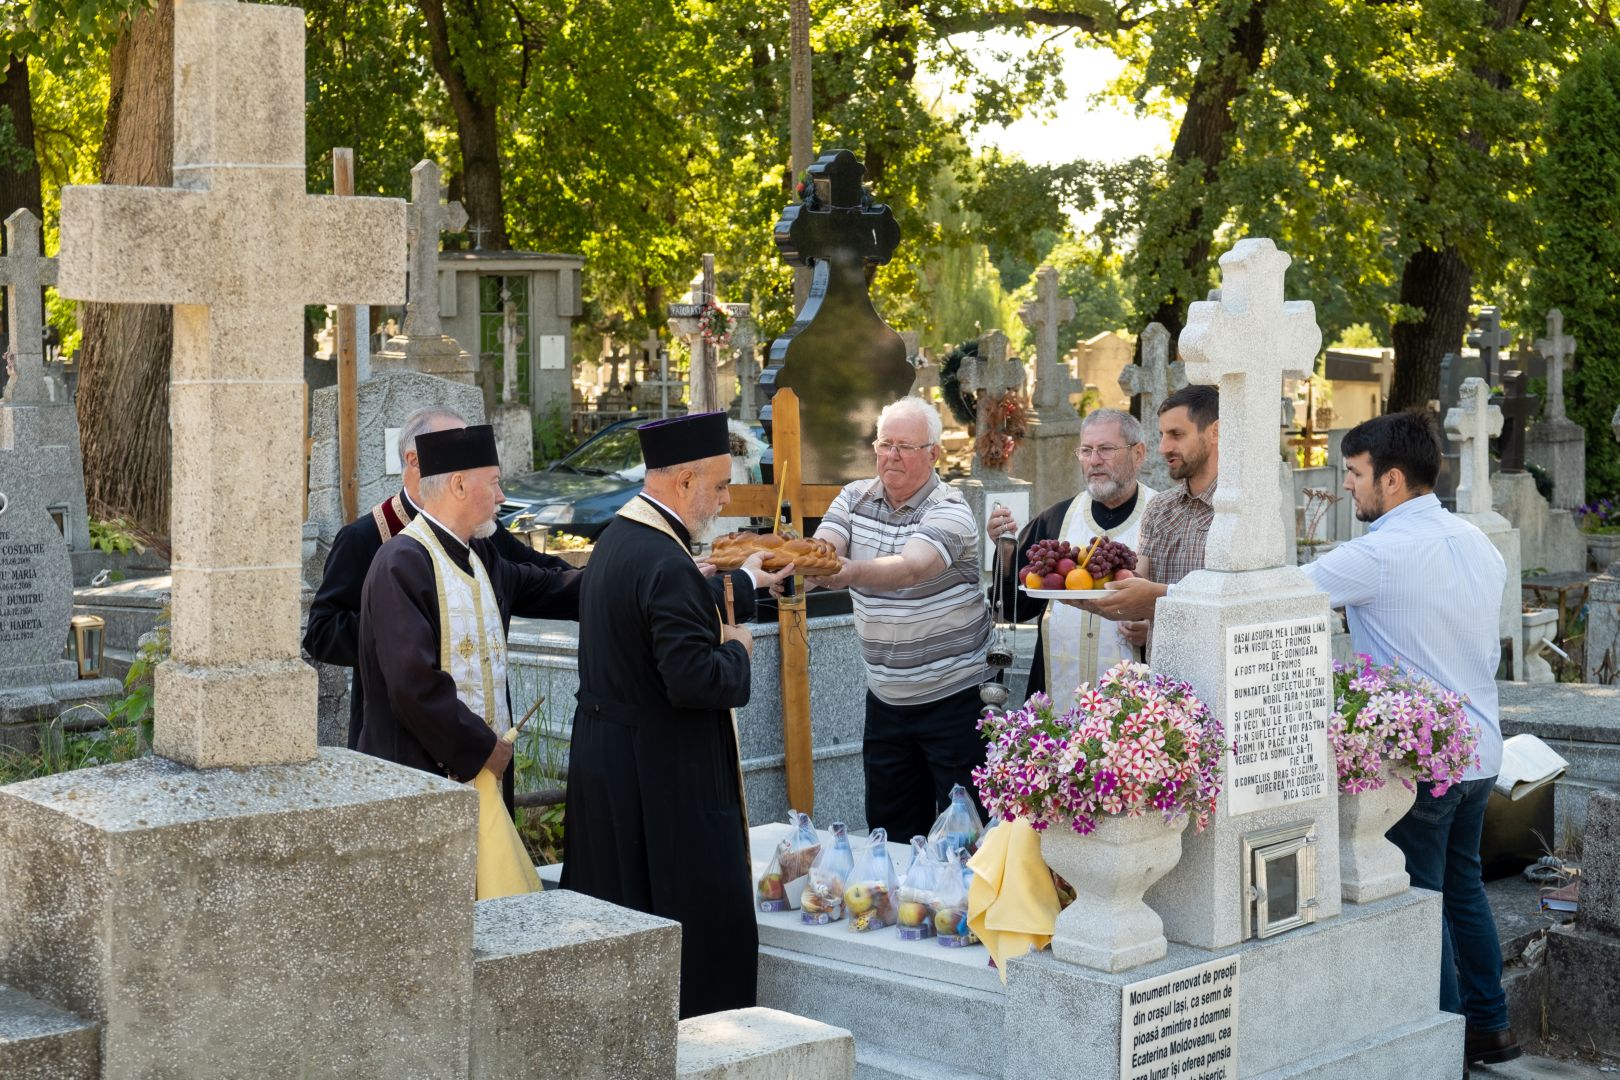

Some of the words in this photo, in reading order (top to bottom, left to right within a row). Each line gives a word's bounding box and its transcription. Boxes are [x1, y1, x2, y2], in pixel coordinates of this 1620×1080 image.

[2, 544, 45, 556] COSTACHE
[12, 569, 37, 581] MARIA
[7, 593, 44, 606] DUMITRU
[10, 619, 43, 631] HARETA
[1252, 629, 1273, 641] ASUPRA
[1275, 627, 1288, 639] MEA
[1290, 624, 1312, 637] LUMINA
[1312, 622, 1326, 633] LINA
[1234, 643, 1249, 654] CA-N
[1251, 641, 1270, 653] VISUL
[1271, 640, 1283, 650] CEL
[1285, 636, 1311, 648] FRUMOS
[1240, 665, 1257, 675] FOST
[1258, 662, 1274, 672] PREA
[1277, 659, 1301, 671] FRUMOS
[1271, 673, 1279, 681] CA
[1281, 671, 1290, 680] SA
[1292, 669, 1304, 680] MAI
[1306, 667, 1316, 677] FIE
[1234, 685, 1270, 699] BUNATATEA
[1273, 680, 1312, 693] SUFLETULUI
[1314, 677, 1325, 687] TAU
[1262, 693, 1282, 706] NOBIL
[1284, 691, 1299, 702] FARA
[1300, 687, 1325, 699] MARGINI
[1234, 712, 1241, 722] SI
[1243, 707, 1267, 720] CHIPUL
[1269, 705, 1281, 715] TAU
[1304, 700, 1311, 710] SI
[1234, 723, 1241, 733] IN
[1243, 720, 1258, 731] VECI
[1261, 717, 1271, 728] NU
[1273, 715, 1282, 726] LE
[1298, 710, 1313, 721] UITA
[1234, 732, 1249, 743] SI-N
[1251, 727, 1276, 741] SUFLET
[1278, 725, 1287, 736] LE
[1289, 723, 1300, 734] VOI
[1301, 720, 1325, 732] PASTRA
[1257, 741, 1265, 751] IN
[1268, 737, 1285, 749] PACE
[1288, 735, 1298, 745] AM
[1300, 733, 1309, 743] SA
[1234, 754, 1258, 766] VEGHEZ
[1260, 751, 1269, 761] CA
[1270, 746, 1295, 759] SOMNUL
[1296, 743, 1313, 755] SA-TI
[1289, 756, 1299, 767] FIE
[1302, 754, 1314, 764] LIN
[1240, 773, 1271, 787] CORNELUS
[1273, 769, 1289, 780] DRAG
[1290, 767, 1297, 777] SI
[1298, 764, 1319, 776] SCUMP
[1256, 780, 1285, 795] DUREREA
[1283, 789, 1299, 801] RICA
[1301, 785, 1321, 797] SOTIE
[1129, 982, 1171, 1007] Monument
[1172, 973, 1201, 994] renovat
[1202, 970, 1211, 984] de
[1133, 1011, 1146, 1027] din
[1147, 1001, 1172, 1022] orașul
[1190, 996, 1200, 1009] ca
[1201, 990, 1222, 1005] semn
[1223, 984, 1232, 998] de
[1133, 1026, 1159, 1050] pioasă
[1160, 1017, 1192, 1039] amintire
[1193, 1016, 1198, 1028] a
[1199, 1003, 1231, 1026] doamnei
[1131, 1046, 1168, 1069] Ecaterina
[1169, 1031, 1217, 1056] Moldoveanu,
[1218, 1026, 1232, 1041] cea
[1150, 1066, 1170, 1080] lunar
[1181, 1055, 1205, 1073] oferea
[1206, 1044, 1231, 1068] pensia
